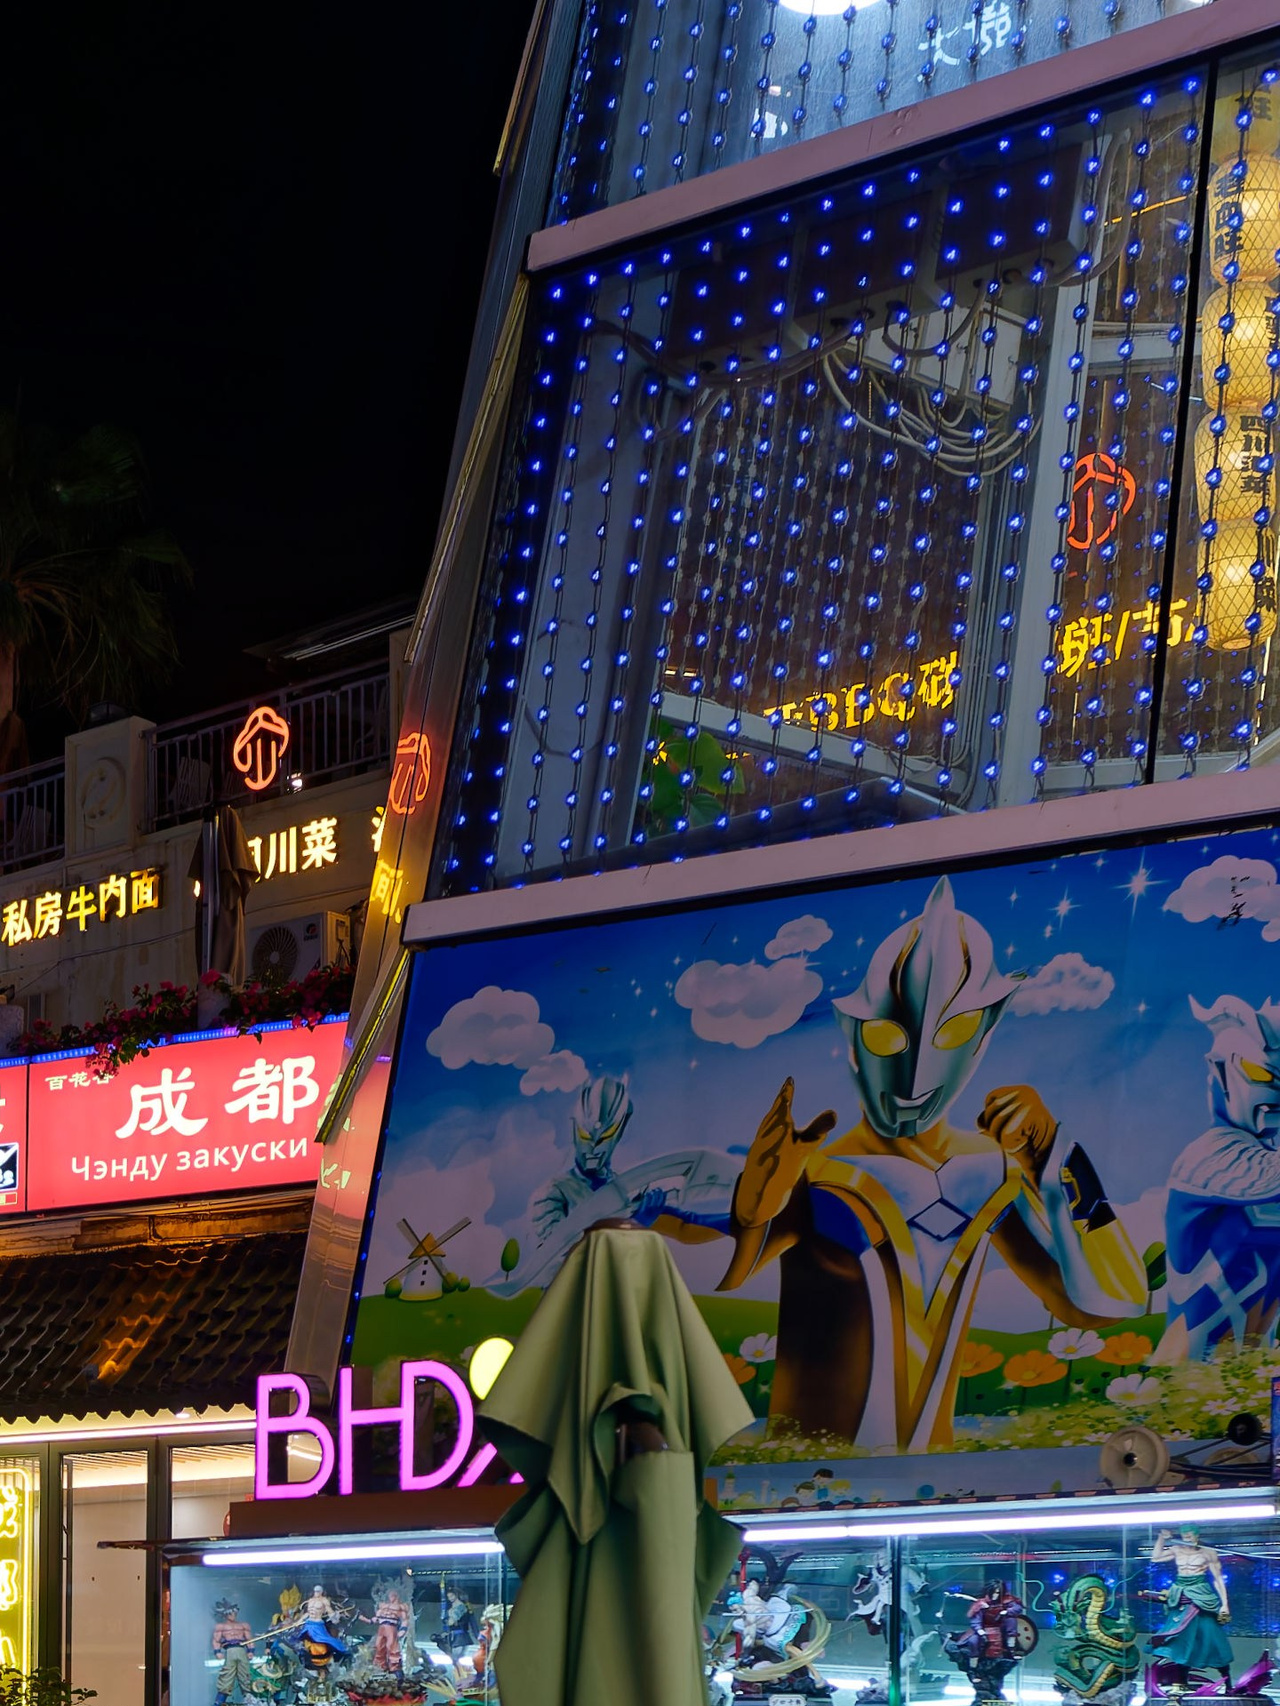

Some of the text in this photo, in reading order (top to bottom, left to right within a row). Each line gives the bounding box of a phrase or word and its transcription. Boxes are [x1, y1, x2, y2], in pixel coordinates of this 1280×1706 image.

[114, 1055, 340, 1140] 成都
[70, 1136, 309, 1183] Чэнду закуски
[255, 1358, 526, 1501] BHD
